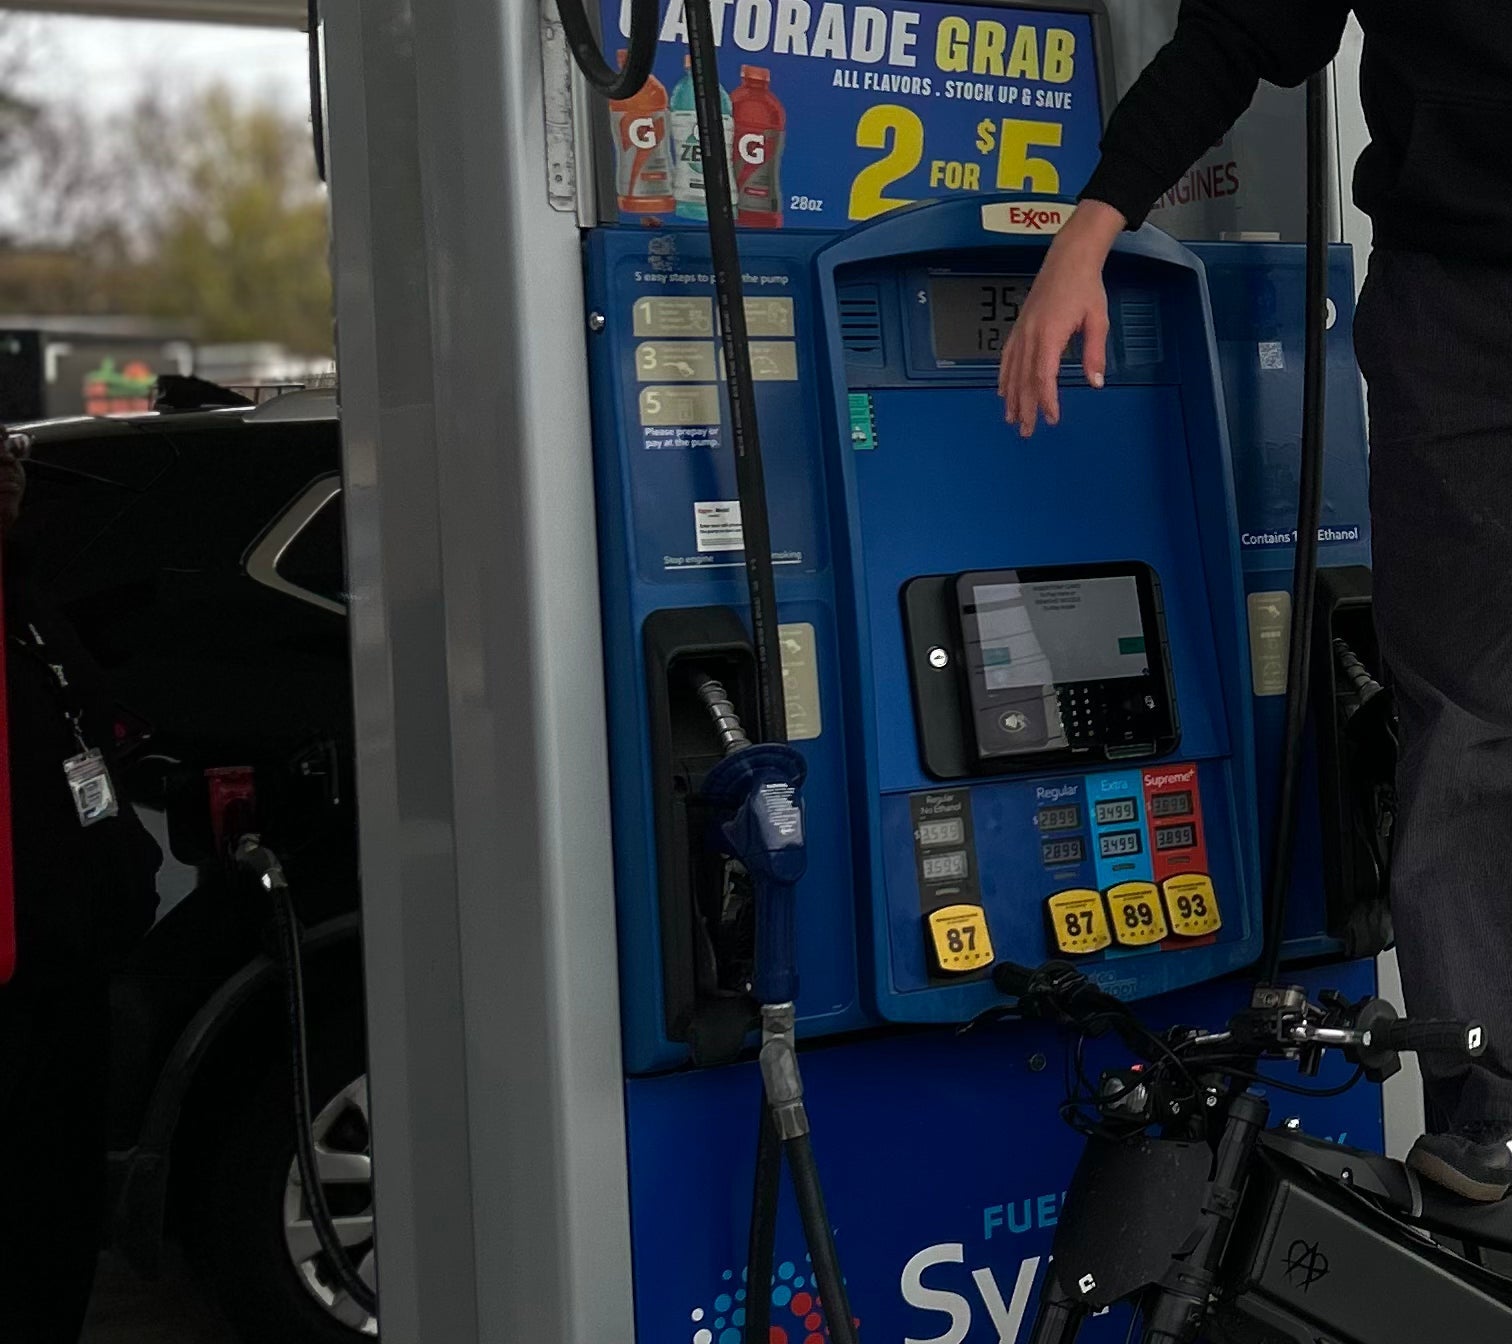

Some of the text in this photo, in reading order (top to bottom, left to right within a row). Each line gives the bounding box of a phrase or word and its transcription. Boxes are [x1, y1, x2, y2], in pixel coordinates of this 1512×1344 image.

[935, 16, 1076, 84] GRAB
[832, 69, 860, 89] ALL
[864, 72, 932, 96] FLAVORS
[945, 81, 994, 102] STOCK
[998, 86, 1018, 105] UP
[1021, 88, 1032, 106] &
[1035, 90, 1072, 110] SAVE
[628, 117, 657, 149] G
[680, 143, 703, 162] ZE
[738, 133, 766, 164] G
[848, 104, 1064, 221] 2 FOR $5
[1153, 161, 1240, 208] NGINES
[790, 195, 823, 211] 28oz
[1009, 206, 1062, 230] Exxon
[698, 272, 709, 282] to
[760, 274, 789, 285] pump
[639, 302, 651, 324] 1
[917, 286, 1022, 322] $ 35
[642, 346, 657, 369] 3
[646, 391, 661, 414] 5
[1241, 528, 1291, 546] Contains
[1317, 526, 1359, 541] Ethanol
[1036, 783, 1079, 801] Regular
[1101, 779, 1128, 792] Extra
[1123, 901, 1154, 929] 89
[1176, 893, 1208, 919] 93
[1064, 910, 1094, 937] 87
[945, 925, 977, 953] 87
[983, 1190, 1068, 1240] FUE
